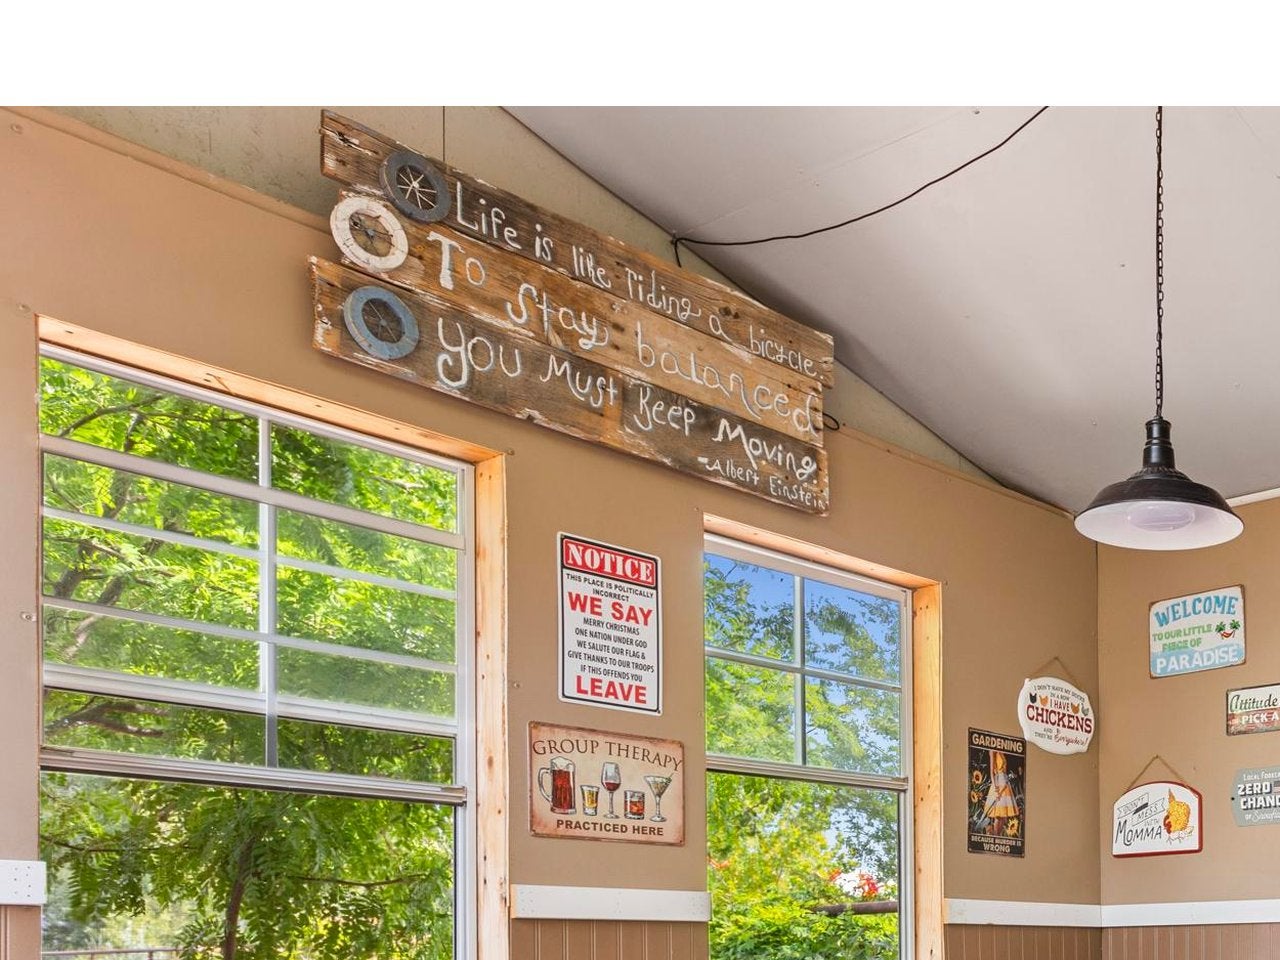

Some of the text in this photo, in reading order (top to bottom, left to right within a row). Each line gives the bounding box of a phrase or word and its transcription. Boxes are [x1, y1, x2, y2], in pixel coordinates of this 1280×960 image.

[456, 181, 522, 250] Life
[534, 223, 554, 262] is
[572, 245, 612, 289] like
[625, 267, 702, 322] riding
[709, 314, 732, 343] a
[425, 231, 486, 291] To
[636, 320, 820, 438] balanced
[711, 418, 817, 480] Moving
[769, 475, 826, 510] Einstein
[567, 543, 653, 583] NOTICE
[566, 573, 582, 583] THIS
[583, 577, 604, 588] PLACE
[614, 584, 654, 599] POLITICALLY
[592, 588, 630, 602] INCORRECT
[567, 591, 653, 627] WE SAY
[1154, 595, 1239, 628] WELCOME
[583, 617, 640, 636] MERRY CHRISTMAS
[1152, 623, 1213, 642] TO OUR LITTLE
[574, 627, 648, 649] ONE NATION UNDER GOD
[1162, 637, 1202, 652] PIECE OF
[576, 639, 646, 660] WE SALUTE OUR FLAG &
[1156, 645, 1239, 674] PARADISE
[567, 650, 655, 673] GIVE THANKS TO OUR TROOPS
[580, 664, 643, 682] IF THIS OFFENDS YOU
[576, 674, 647, 705] LEAVE
[1054, 700, 1070, 712] HAVE
[1229, 693, 1278, 713] Attitude
[1026, 704, 1093, 734] CHICKENS
[1241, 712, 1269, 725] PICK
[1271, 711, 1280, 721] A
[972, 733, 1023, 753] GARDENING
[532, 739, 683, 772] GROUP THERAPY
[1237, 781, 1272, 796] ZERO
[1137, 803, 1158, 820] MESS
[556, 819, 664, 836] PRACTICED HERE
[971, 835, 994, 844] BECAUSE
[983, 843, 1011, 853] WRONG
